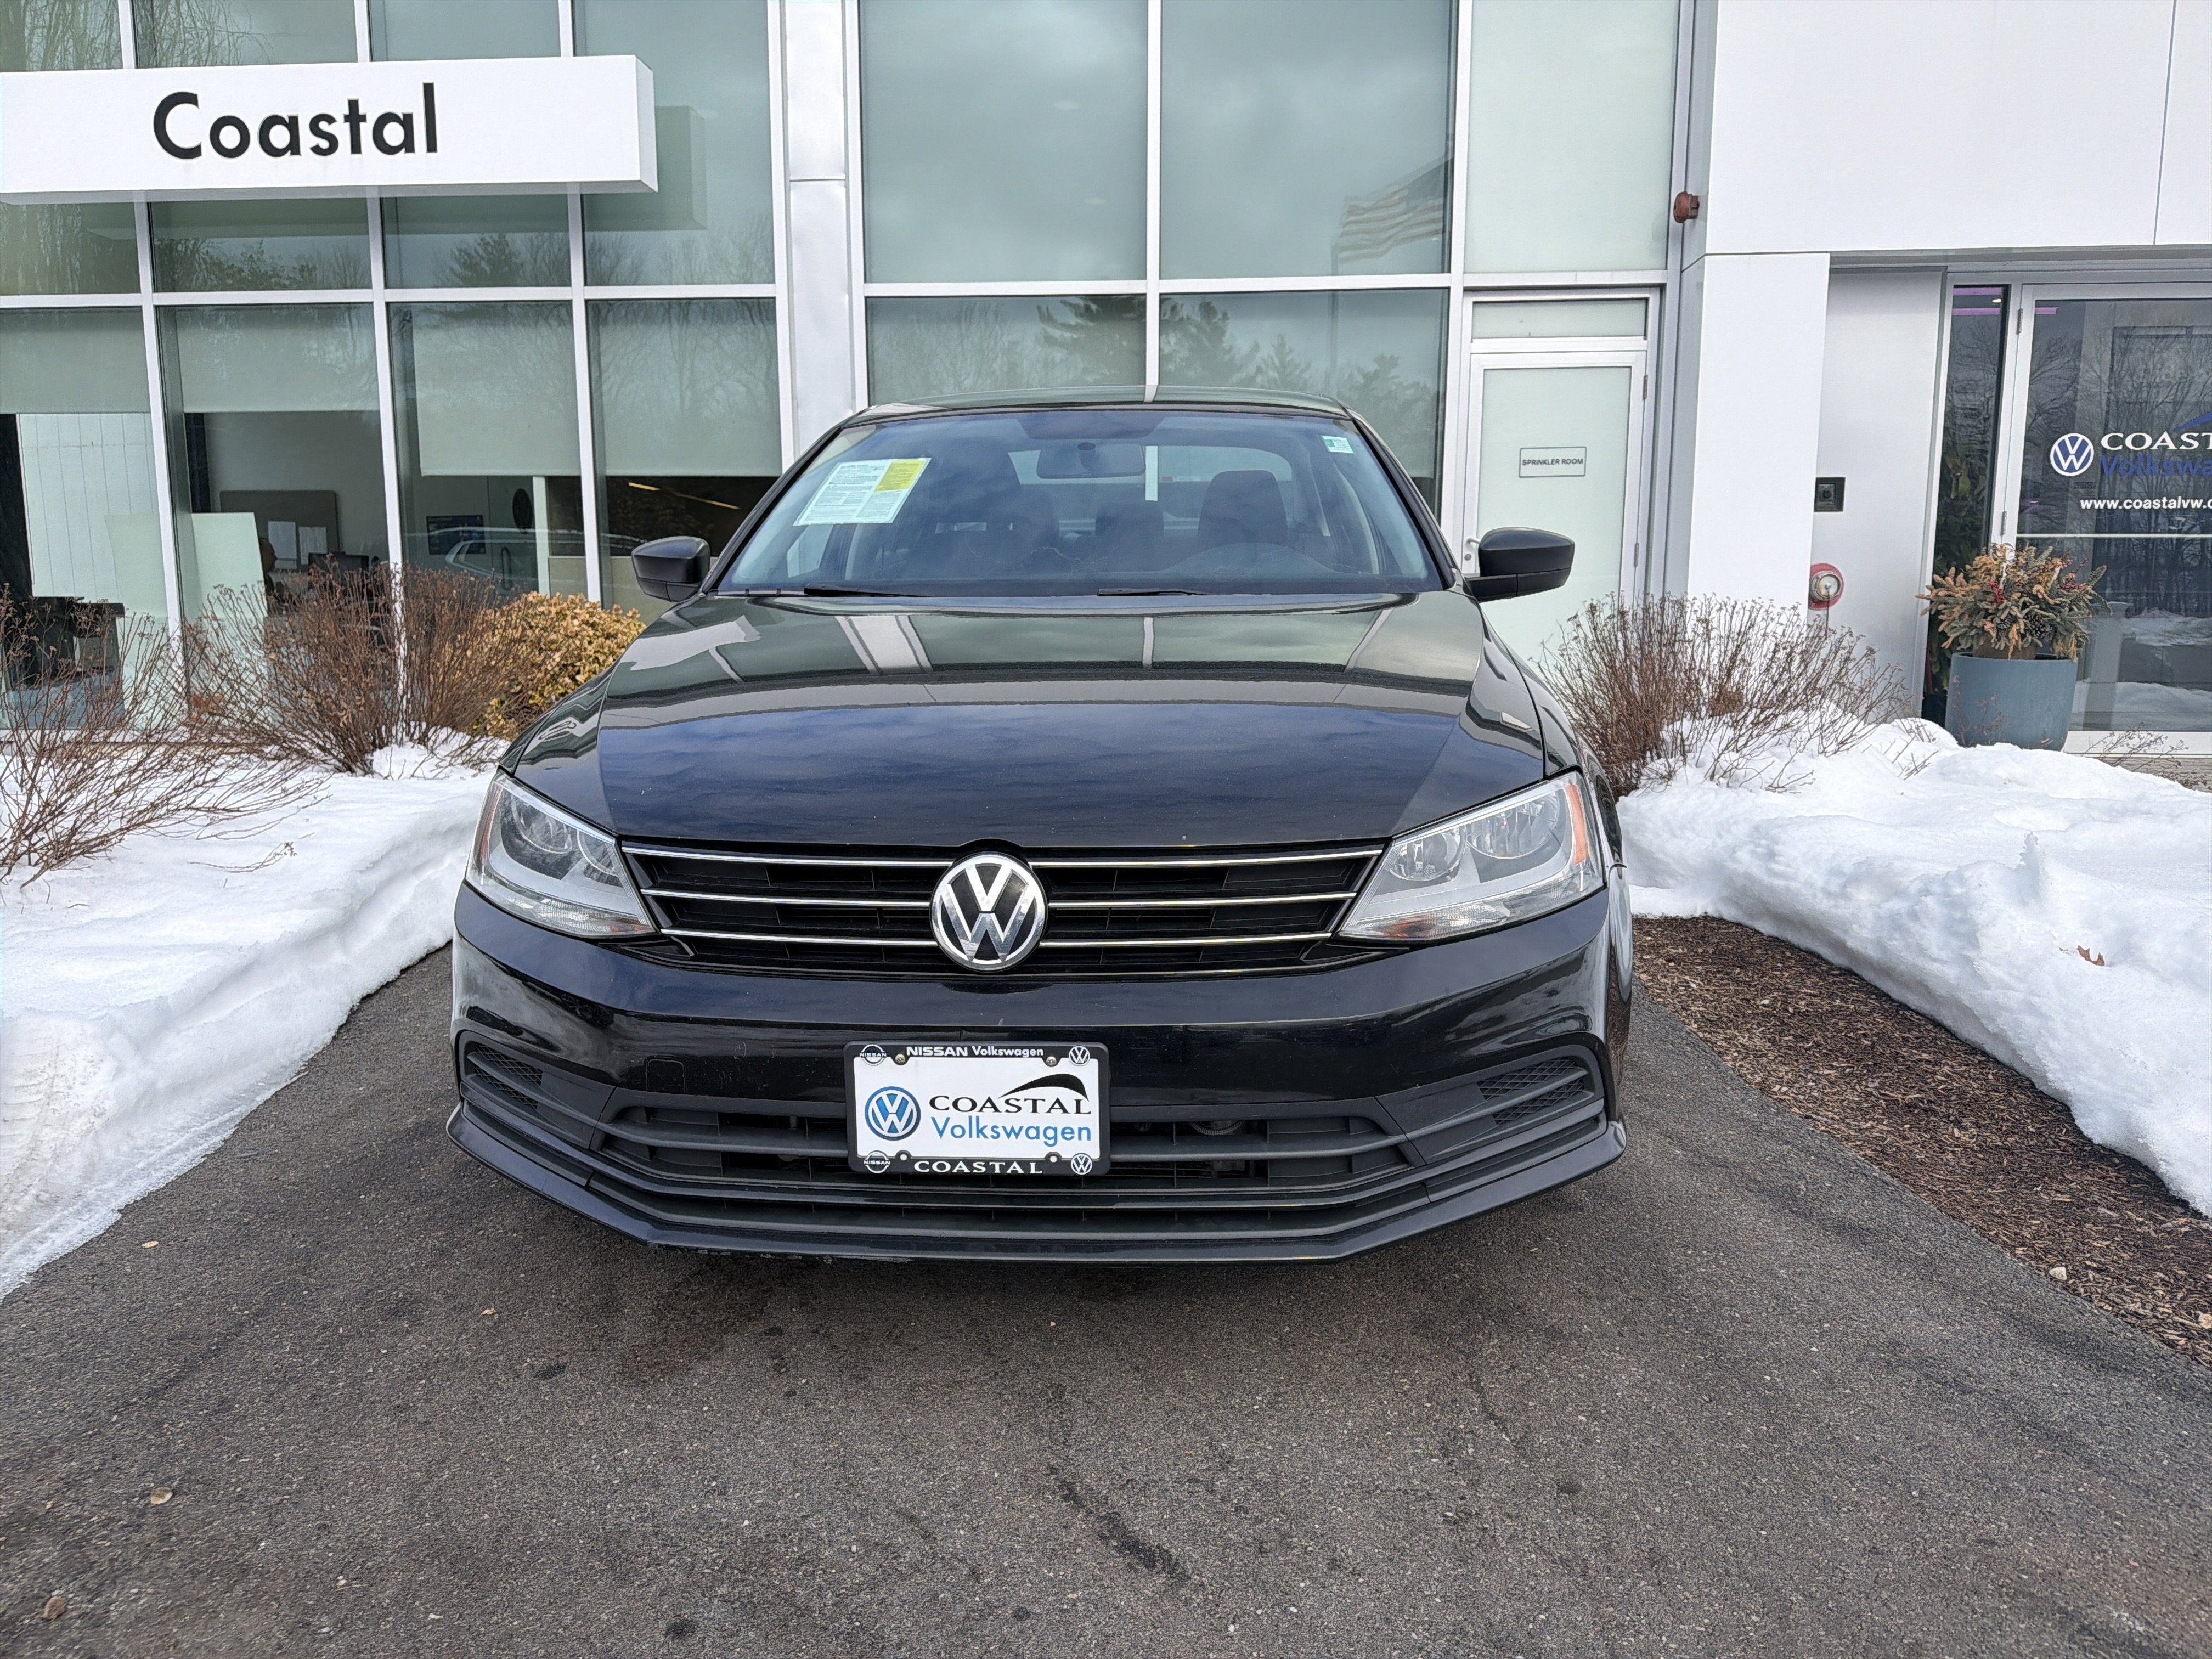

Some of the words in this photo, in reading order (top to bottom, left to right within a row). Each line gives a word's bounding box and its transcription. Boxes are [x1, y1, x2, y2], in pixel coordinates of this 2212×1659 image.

[154, 82, 438, 160] Coastal
[2051, 433, 2094, 476] VW
[934, 857, 1042, 966] VW
[906, 1046, 968, 1056] NISSAN
[972, 1045, 1043, 1058] Volkswagen
[929, 1095, 1091, 1115] COASTAL
[931, 1116, 1091, 1147] Volkswagen
[914, 1159, 1043, 1174] COASTAL
